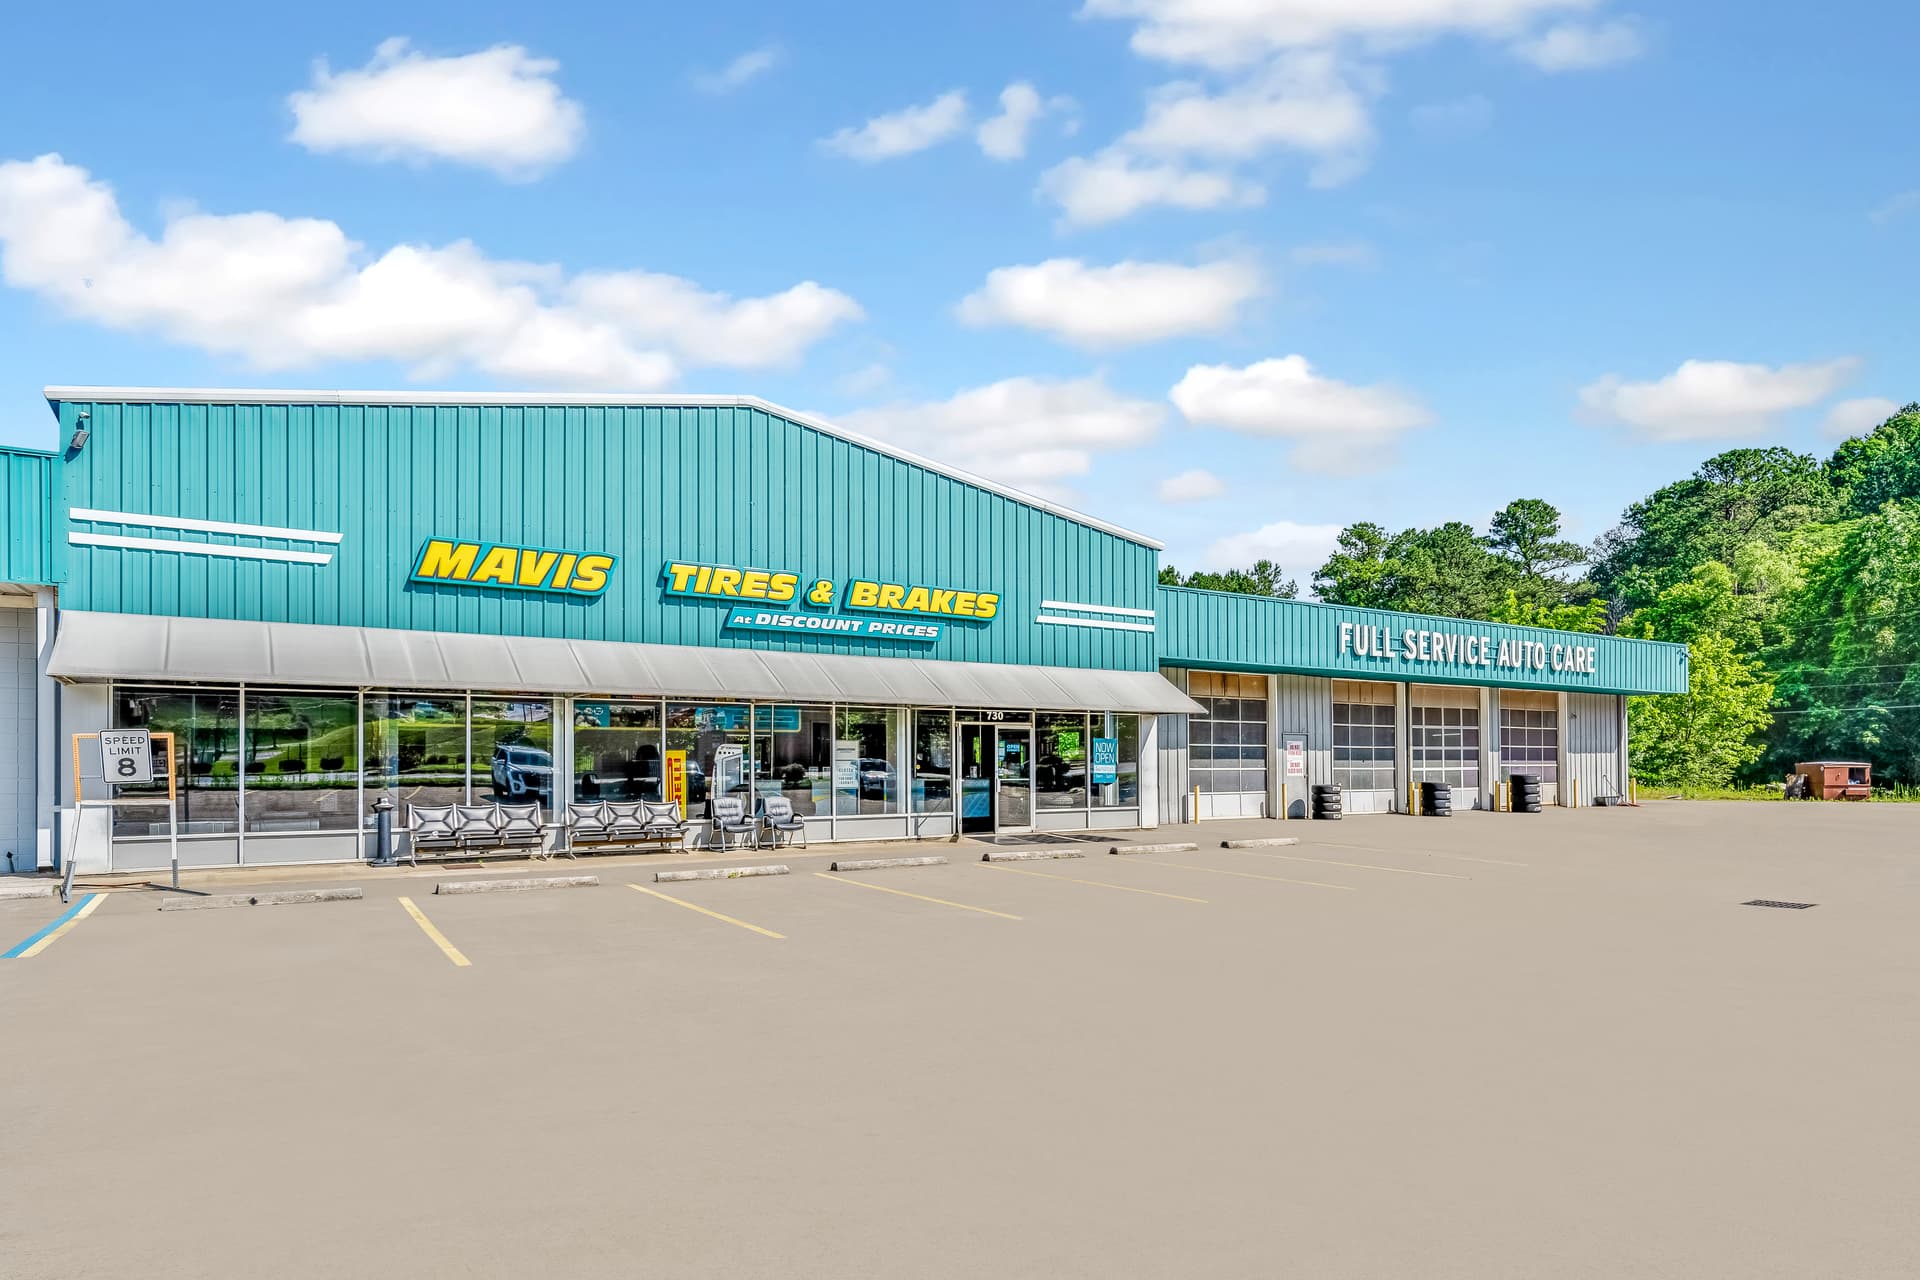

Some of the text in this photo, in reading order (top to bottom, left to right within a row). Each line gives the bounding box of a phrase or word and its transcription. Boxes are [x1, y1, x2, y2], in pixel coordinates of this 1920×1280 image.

[417, 540, 999, 619] MAVIS TIRES & BRAKES
[733, 613, 939, 637] At DISCOUNT PRICES
[1338, 622, 1596, 673] FULL SERVICE AUTO CARE
[987, 711, 1004, 721] 730
[104, 736, 145, 745] SPEED
[109, 746, 142, 756] LIMIT
[1095, 742, 1115, 753] NOW
[1095, 753, 1115, 764] OPEN
[118, 757, 137, 777] 8
